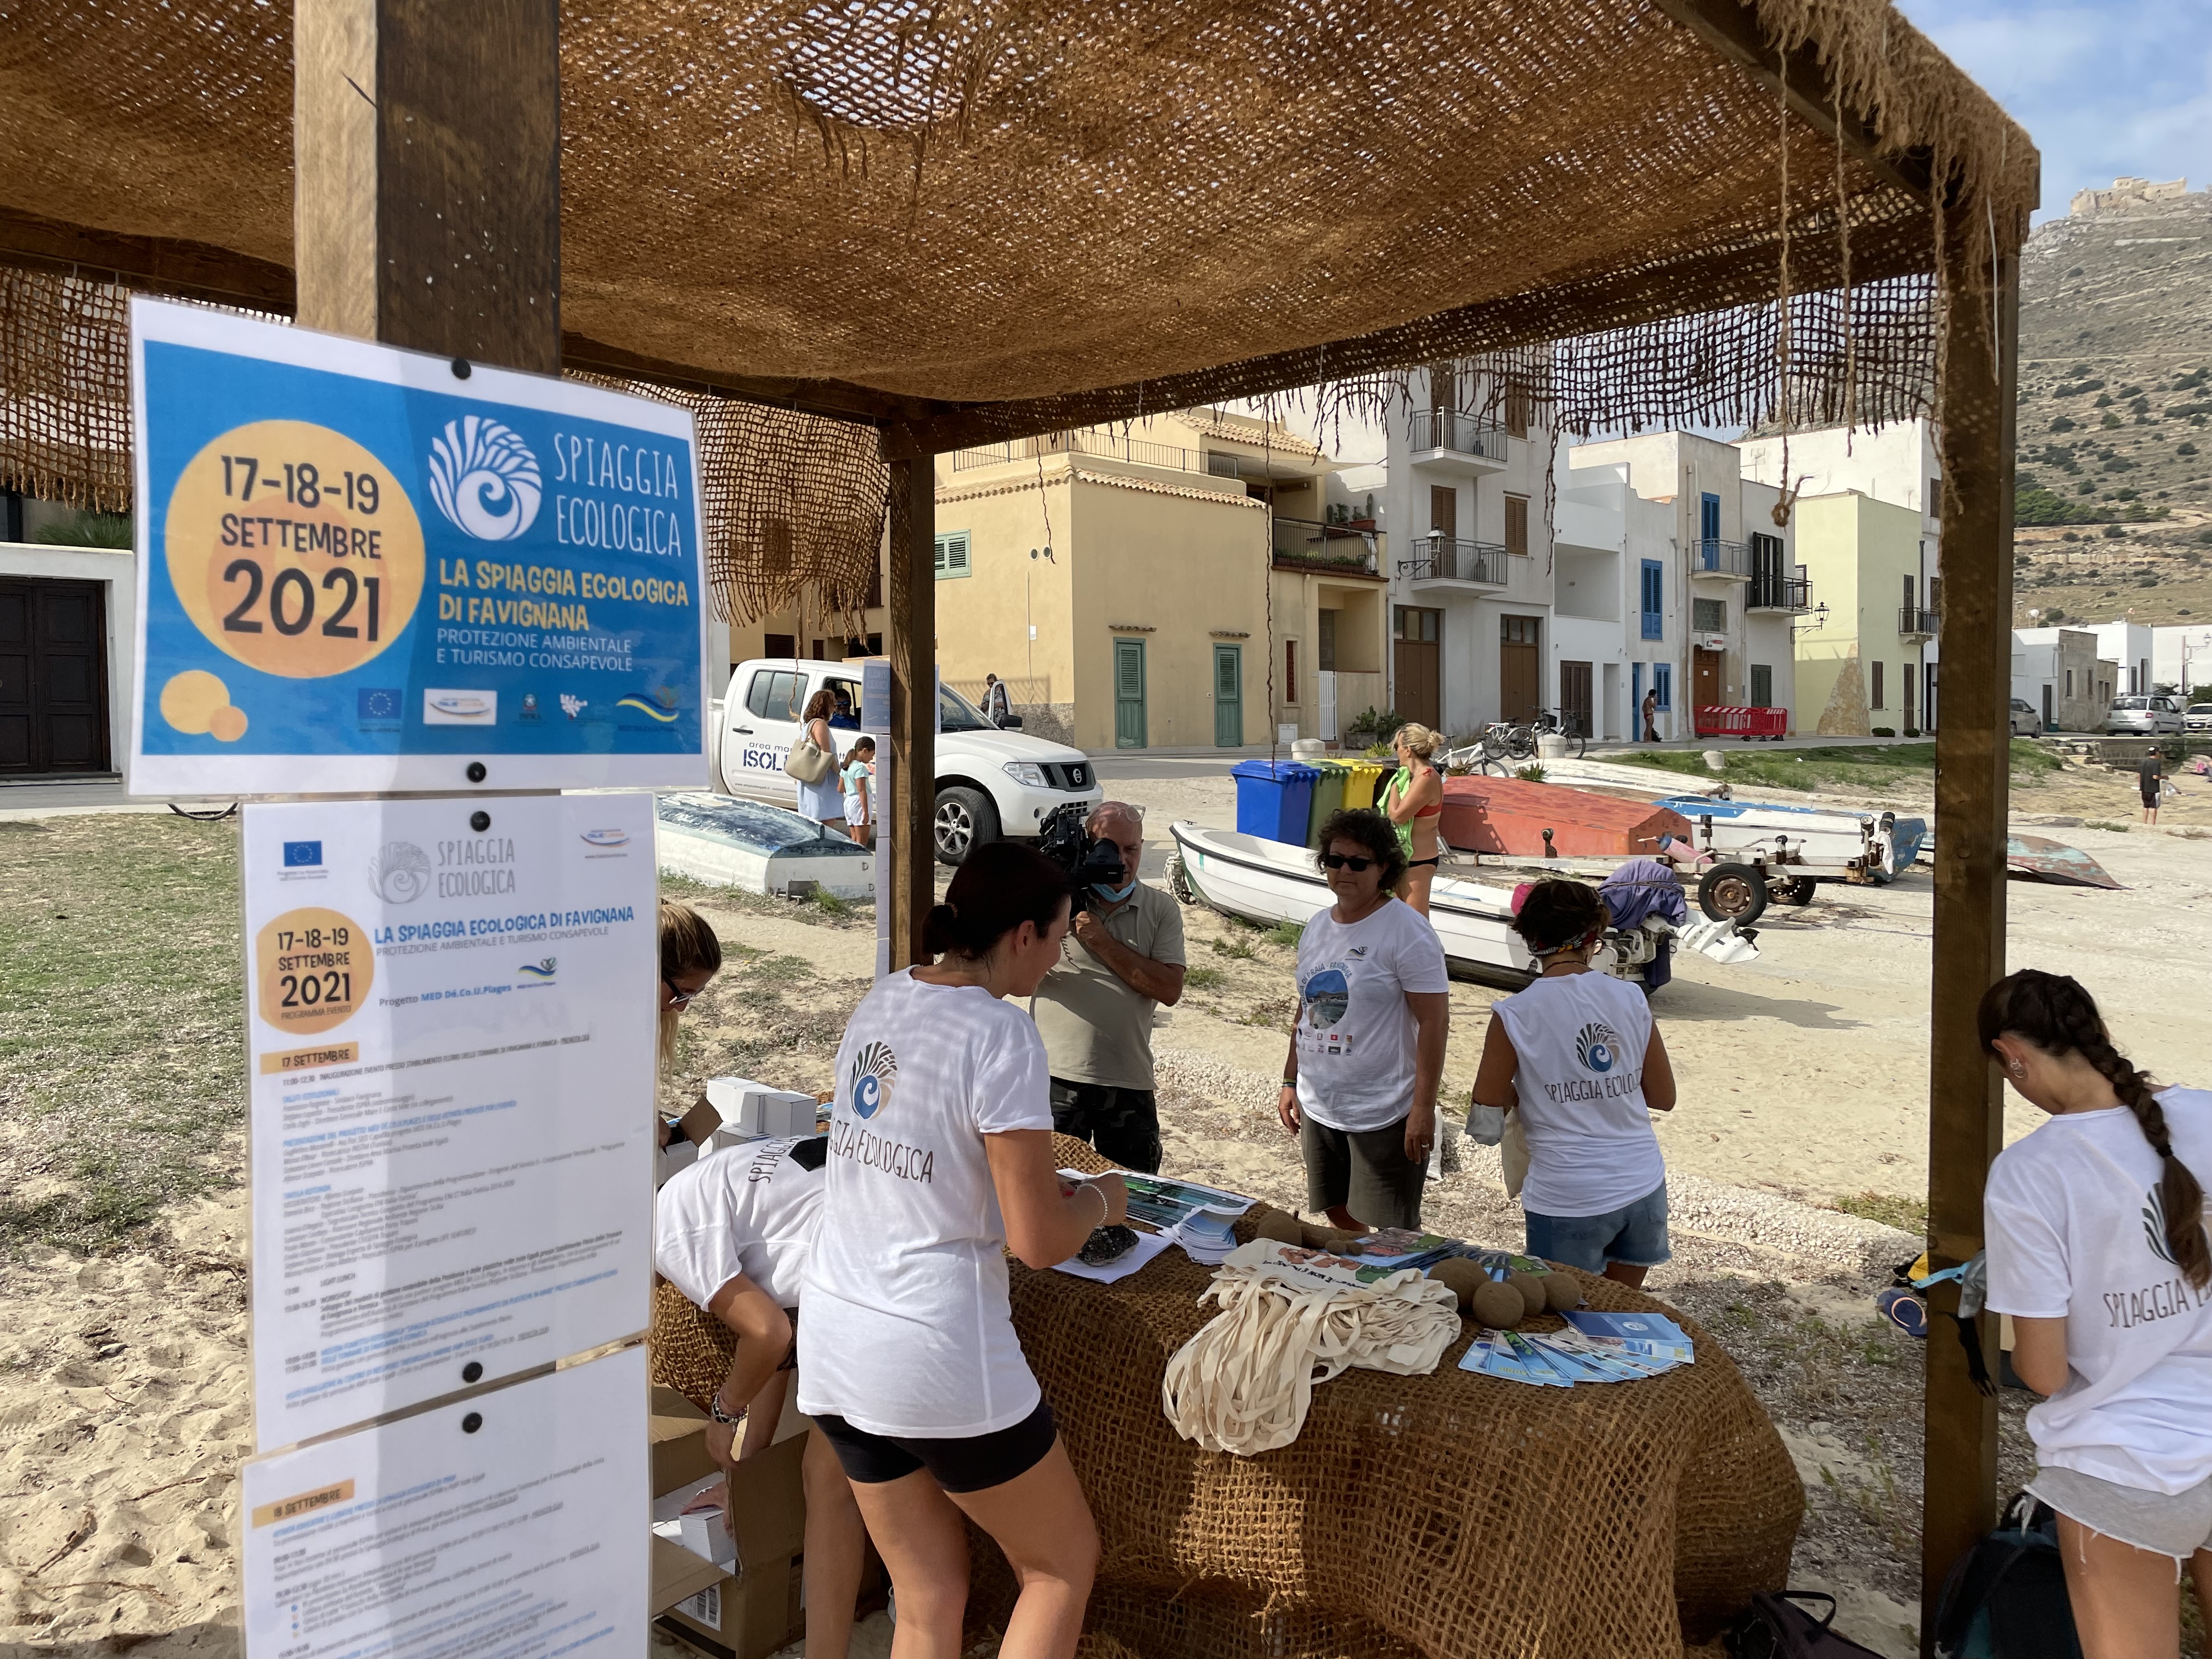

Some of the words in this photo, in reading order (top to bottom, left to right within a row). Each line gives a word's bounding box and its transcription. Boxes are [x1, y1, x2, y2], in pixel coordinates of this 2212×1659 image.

[553, 431, 679, 500] SPIAGGIA
[221, 455, 380, 515] 17-18-19
[221, 514, 382, 560] SETTEMBRE
[556, 495, 681, 558] ECOLOGICA
[439, 558, 469, 588] LA
[476, 560, 577, 596] SPIAGGIA
[223, 558, 380, 642] 2021
[439, 593, 462, 621] DI
[468, 597, 589, 631] FAVIGNANA
[437, 628, 538, 648] PROTEZIONE
[542, 635, 631, 653] AMBIENTALE
[437, 648, 445, 663] E
[452, 649, 524, 667] TURISMO
[529, 653, 633, 672] CONSAPEVOLE
[438, 838, 515, 866] SPIAGGIA
[438, 869, 516, 898] ECOLOGICA
[278, 928, 348, 951] 17-18-19
[374, 926, 393, 944] LA
[398, 919, 465, 941] SPIAGGIA
[470, 913, 547, 935] ECOLOGICA
[550, 911, 562, 927] DI
[566, 906, 635, 926] FAVIGNANA
[376, 943, 437, 957] PROTEZIONE
[440, 938, 497, 951] AMBIENTALE
[499, 936, 505, 945] E
[507, 932, 547, 945] TURISMO
[549, 926, 609, 941] CONSAPEVOLE
[278, 952, 349, 971] SETTEMBRE
[1306, 963, 1325, 978] PRAIA
[280, 971, 349, 1007] 2021
[379, 996, 418, 1007] Progetto
[421, 992, 442, 1002] MED
[281, 1008, 325, 1020] PROGRAMMA
[327, 1005, 351, 1015] EVENTO
[282, 1057, 290, 1067] 17
[294, 1048, 349, 1066] SETTEMBRE
[1545, 1080, 1604, 1103] SPIAGGIA
[748, 1138, 800, 1184] SPIAGGIA
[857, 1129, 933, 1183] ECOLOGICA
[2103, 1278, 2190, 1328] SPIAGGIA
[285, 1488, 341, 1515] SETTEMBRE
